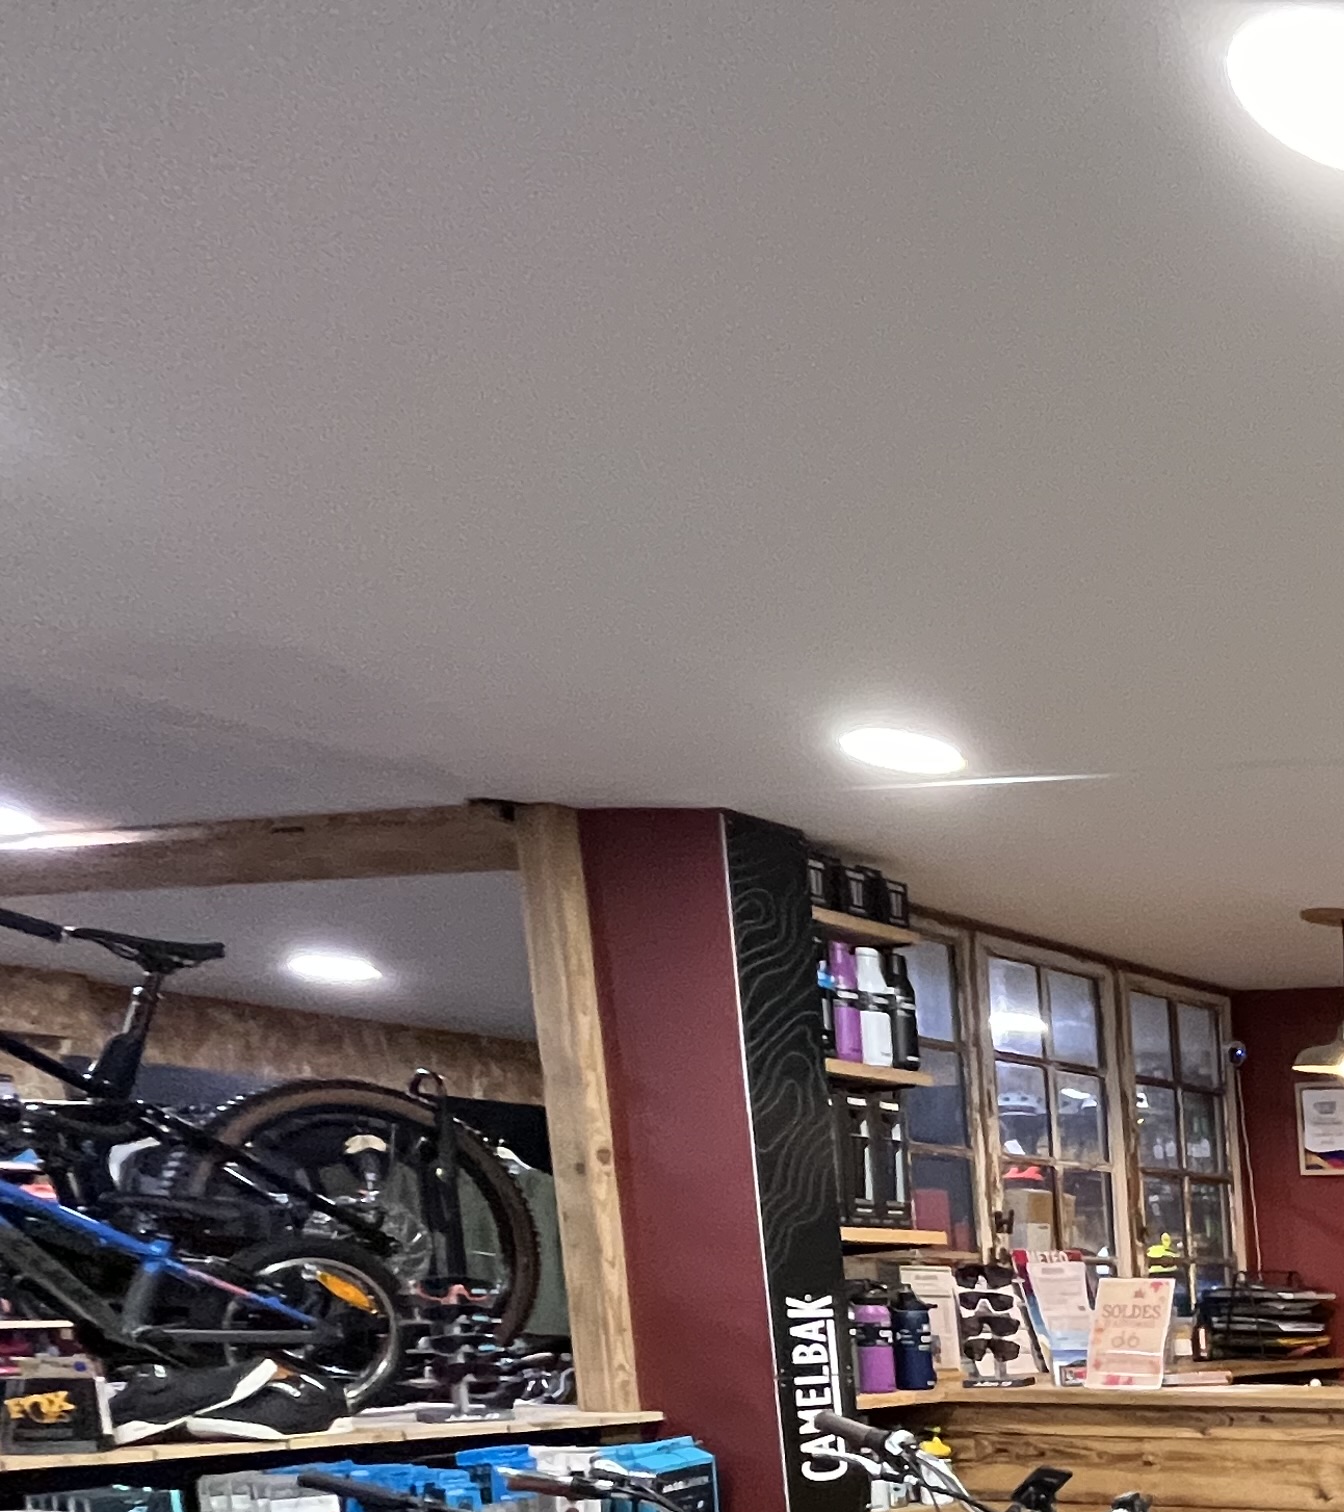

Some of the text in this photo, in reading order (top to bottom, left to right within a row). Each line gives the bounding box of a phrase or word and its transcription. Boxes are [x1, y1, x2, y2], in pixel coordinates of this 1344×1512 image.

[1102, 1304, 1162, 1319] SOLDES
[785, 1294, 849, 1482] CAMELBAK
[3, 1391, 76, 1424] FOX
